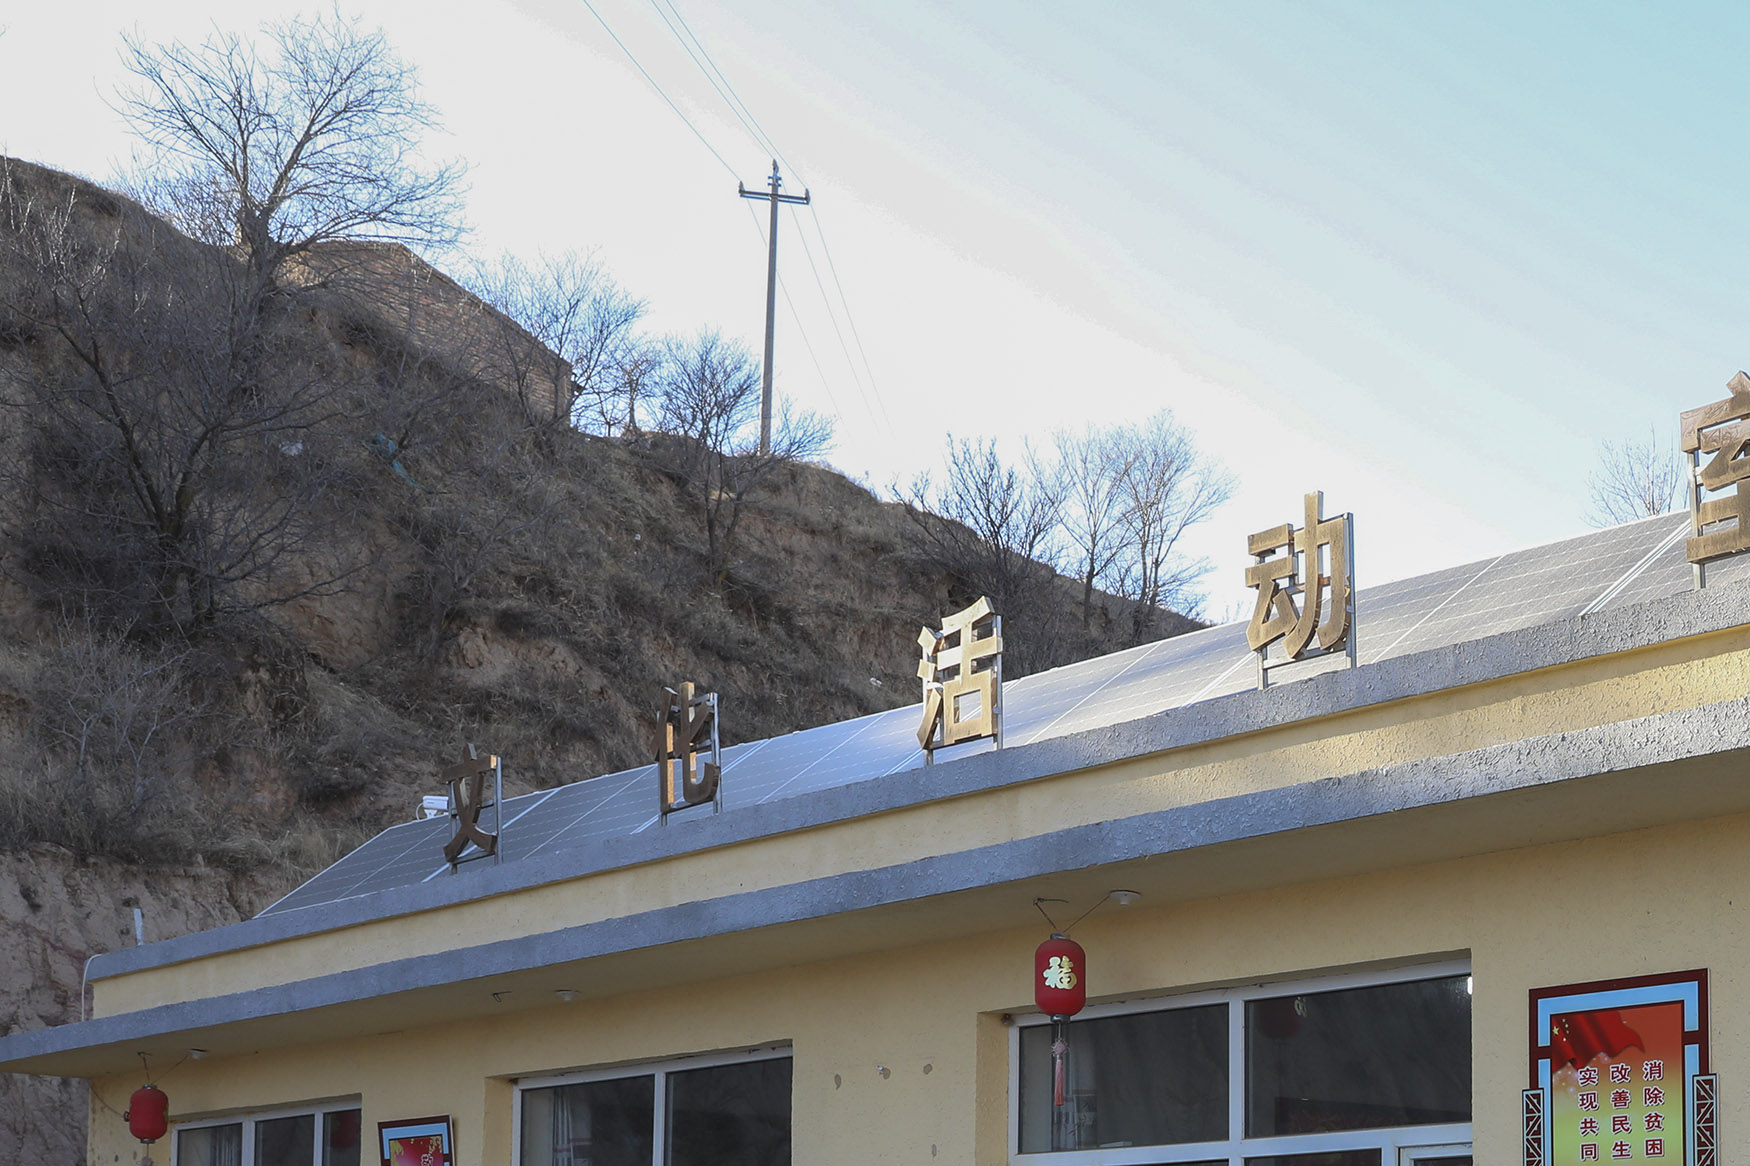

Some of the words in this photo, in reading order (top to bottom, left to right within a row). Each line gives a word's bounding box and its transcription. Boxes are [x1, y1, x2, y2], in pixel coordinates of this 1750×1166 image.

[1042, 955, 1077, 989] 福
[1609, 1063, 1632, 1160] 改善民生
[1642, 1060, 1665, 1158] 消除贫困
